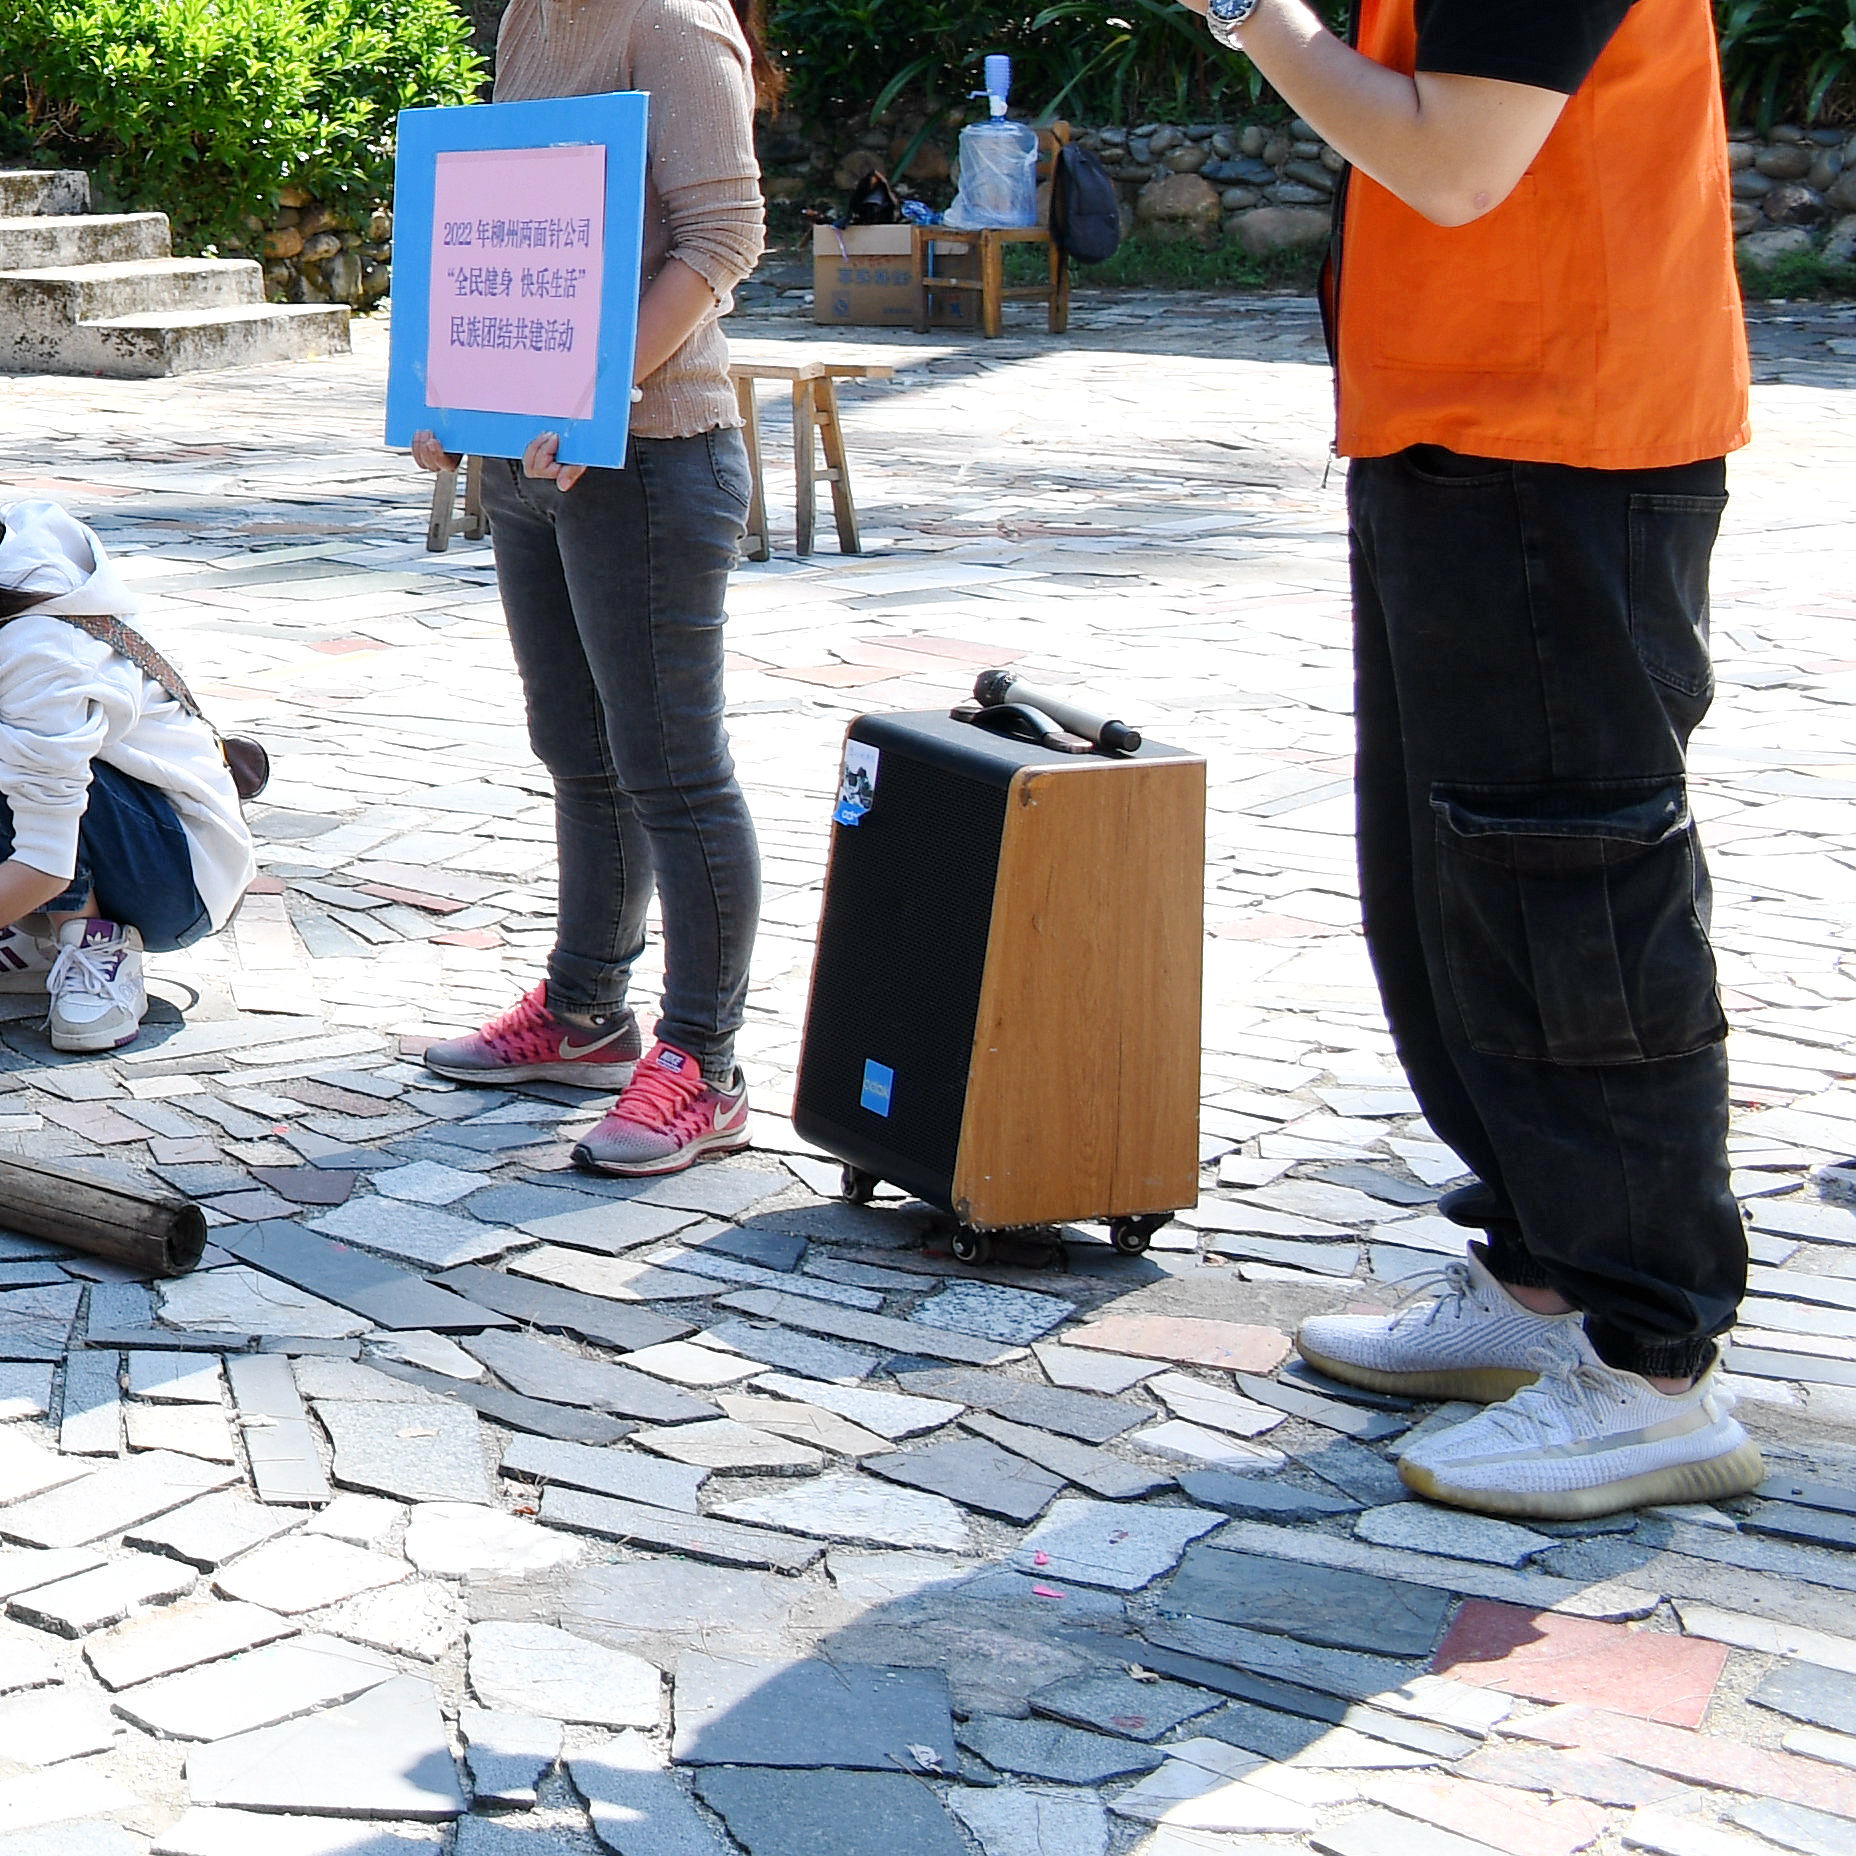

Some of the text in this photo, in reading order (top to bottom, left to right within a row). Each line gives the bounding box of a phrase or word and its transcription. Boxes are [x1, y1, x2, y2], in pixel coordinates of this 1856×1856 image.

[450, 316, 575, 353] 民族团结共建活动
